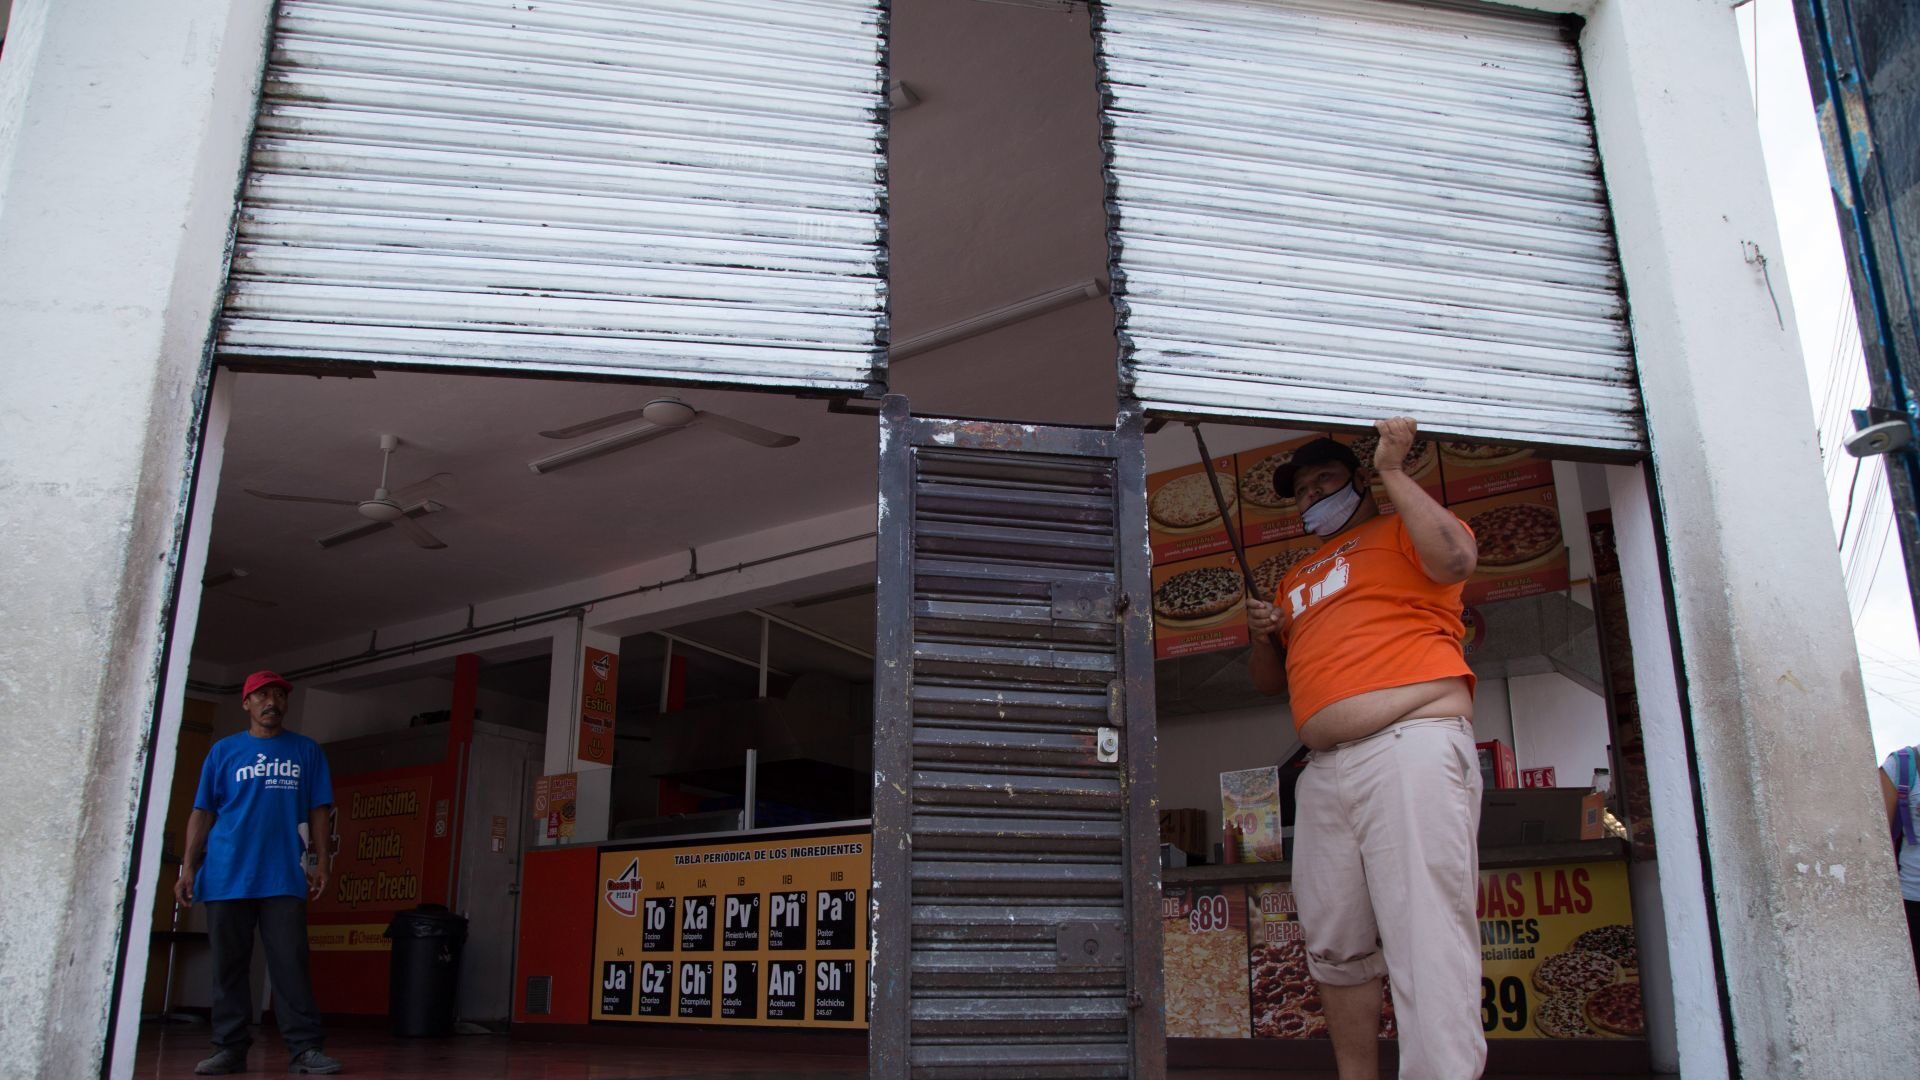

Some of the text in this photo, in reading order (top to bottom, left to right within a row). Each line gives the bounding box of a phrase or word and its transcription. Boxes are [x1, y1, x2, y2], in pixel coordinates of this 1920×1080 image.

[1542, 492, 1552, 500] 10
[585, 696, 612, 713] Estilo
[235, 753, 302, 782] mérida
[351, 786, 420, 820] Buenísima,
[357, 829, 404, 864] Rápida,
[675, 843, 863, 865] TABLA PERIÓDICA DE LOS INGREDIENTES
[697, 879, 707, 889] IIA
[737, 876, 745, 886] IB
[782, 874, 793, 884] IIB
[830, 871, 843, 882] IIIB
[338, 870, 417, 908] Súper Precio
[845, 891, 855, 902] 10
[1476, 868, 1593, 919] DAS LAS
[669, 898, 675, 908] 2
[709, 898, 715, 907] 4
[752, 896, 759, 907] 6
[800, 893, 806, 904] 8
[817, 892, 842, 921] Pa
[1162, 899, 1179, 916] DE
[1261, 893, 1298, 914] GRAN
[645, 900, 665, 930] To
[683, 899, 708, 929] Xa
[725, 897, 751, 928] Pv
[770, 893, 800, 928] Pñ
[1190, 894, 1229, 933] $89
[1265, 922, 1305, 941] PEPP
[1479, 918, 1540, 946] NDES
[617, 947, 625, 956] IA
[1481, 947, 1535, 960] ecialidad
[628, 964, 633, 974] 1
[666, 964, 672, 974] 3
[707, 964, 712, 974] 5
[751, 963, 757, 973] 7
[797, 964, 803, 974] 9
[817, 961, 841, 991] Sh
[844, 962, 852, 973] 11
[604, 964, 626, 990] Ja
[641, 963, 665, 993] Cz
[681, 963, 706, 995] Ch
[723, 963, 737, 995] B
[768, 963, 795, 996] An
[816, 998, 845, 1007] Salchicha
